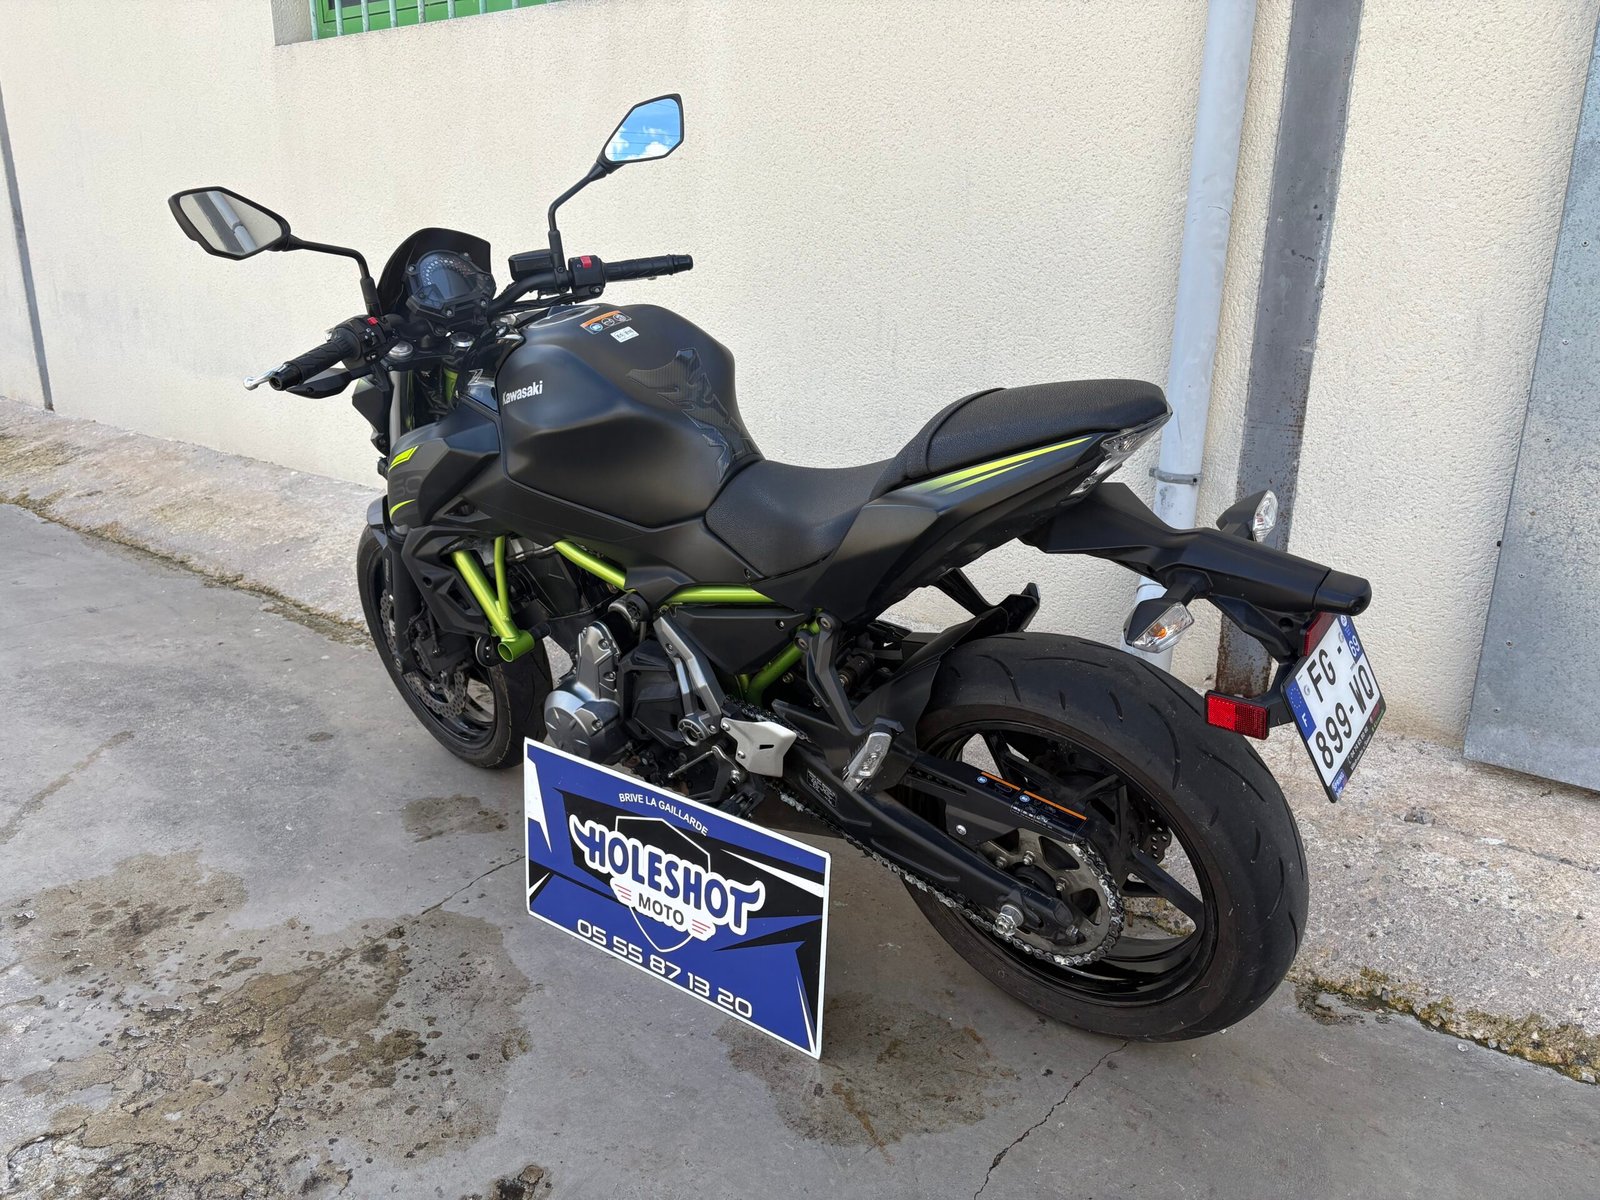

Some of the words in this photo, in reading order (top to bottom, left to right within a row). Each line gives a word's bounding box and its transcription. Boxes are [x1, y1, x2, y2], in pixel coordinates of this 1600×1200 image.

[502, 380, 543, 406] Kawasaki
[1348, 635, 1361, 657] 69
[1301, 712, 1308, 728] F
[1315, 664, 1375, 770] 899-WQ
[618, 792, 644, 804] BRIVE
[645, 795, 657, 808] LA
[658, 798, 709, 836] GAILLARDE
[572, 819, 761, 930] HOLESHOT
[638, 893, 685, 926] MOTO
[577, 919, 607, 946] 05
[612, 936, 643, 964] 55
[649, 955, 682, 980] 87
[687, 972, 711, 998] 13
[717, 987, 753, 1019] 20
